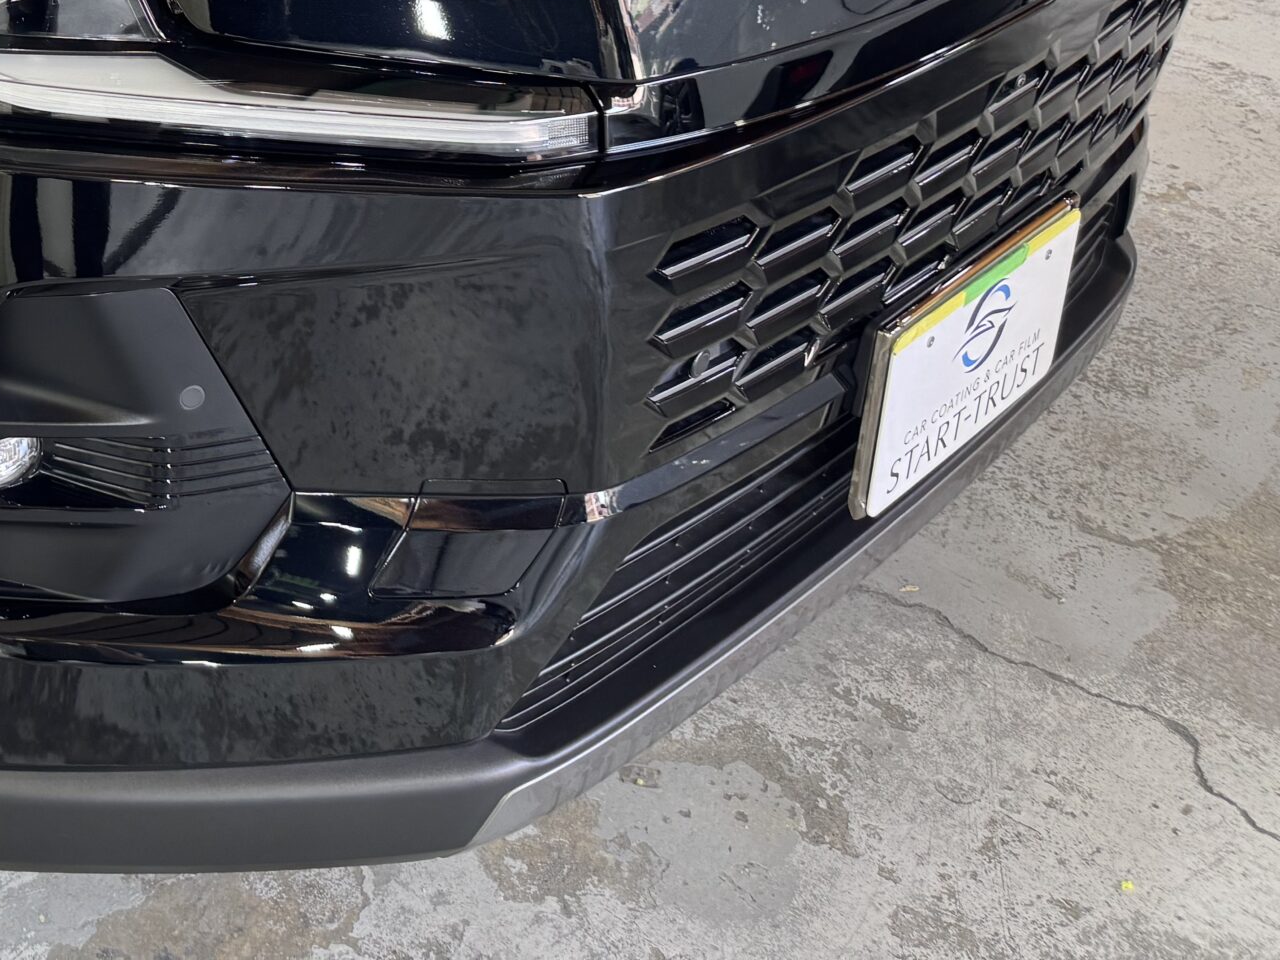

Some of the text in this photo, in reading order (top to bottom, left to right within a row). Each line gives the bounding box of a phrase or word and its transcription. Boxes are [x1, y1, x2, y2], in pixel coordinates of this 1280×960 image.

[886, 342, 1045, 495] START-TRUST
[903, 419, 927, 445] CAR
[930, 377, 981, 424] COATING
[994, 349, 1016, 374] CAR
[1018, 328, 1041, 356] FILM
